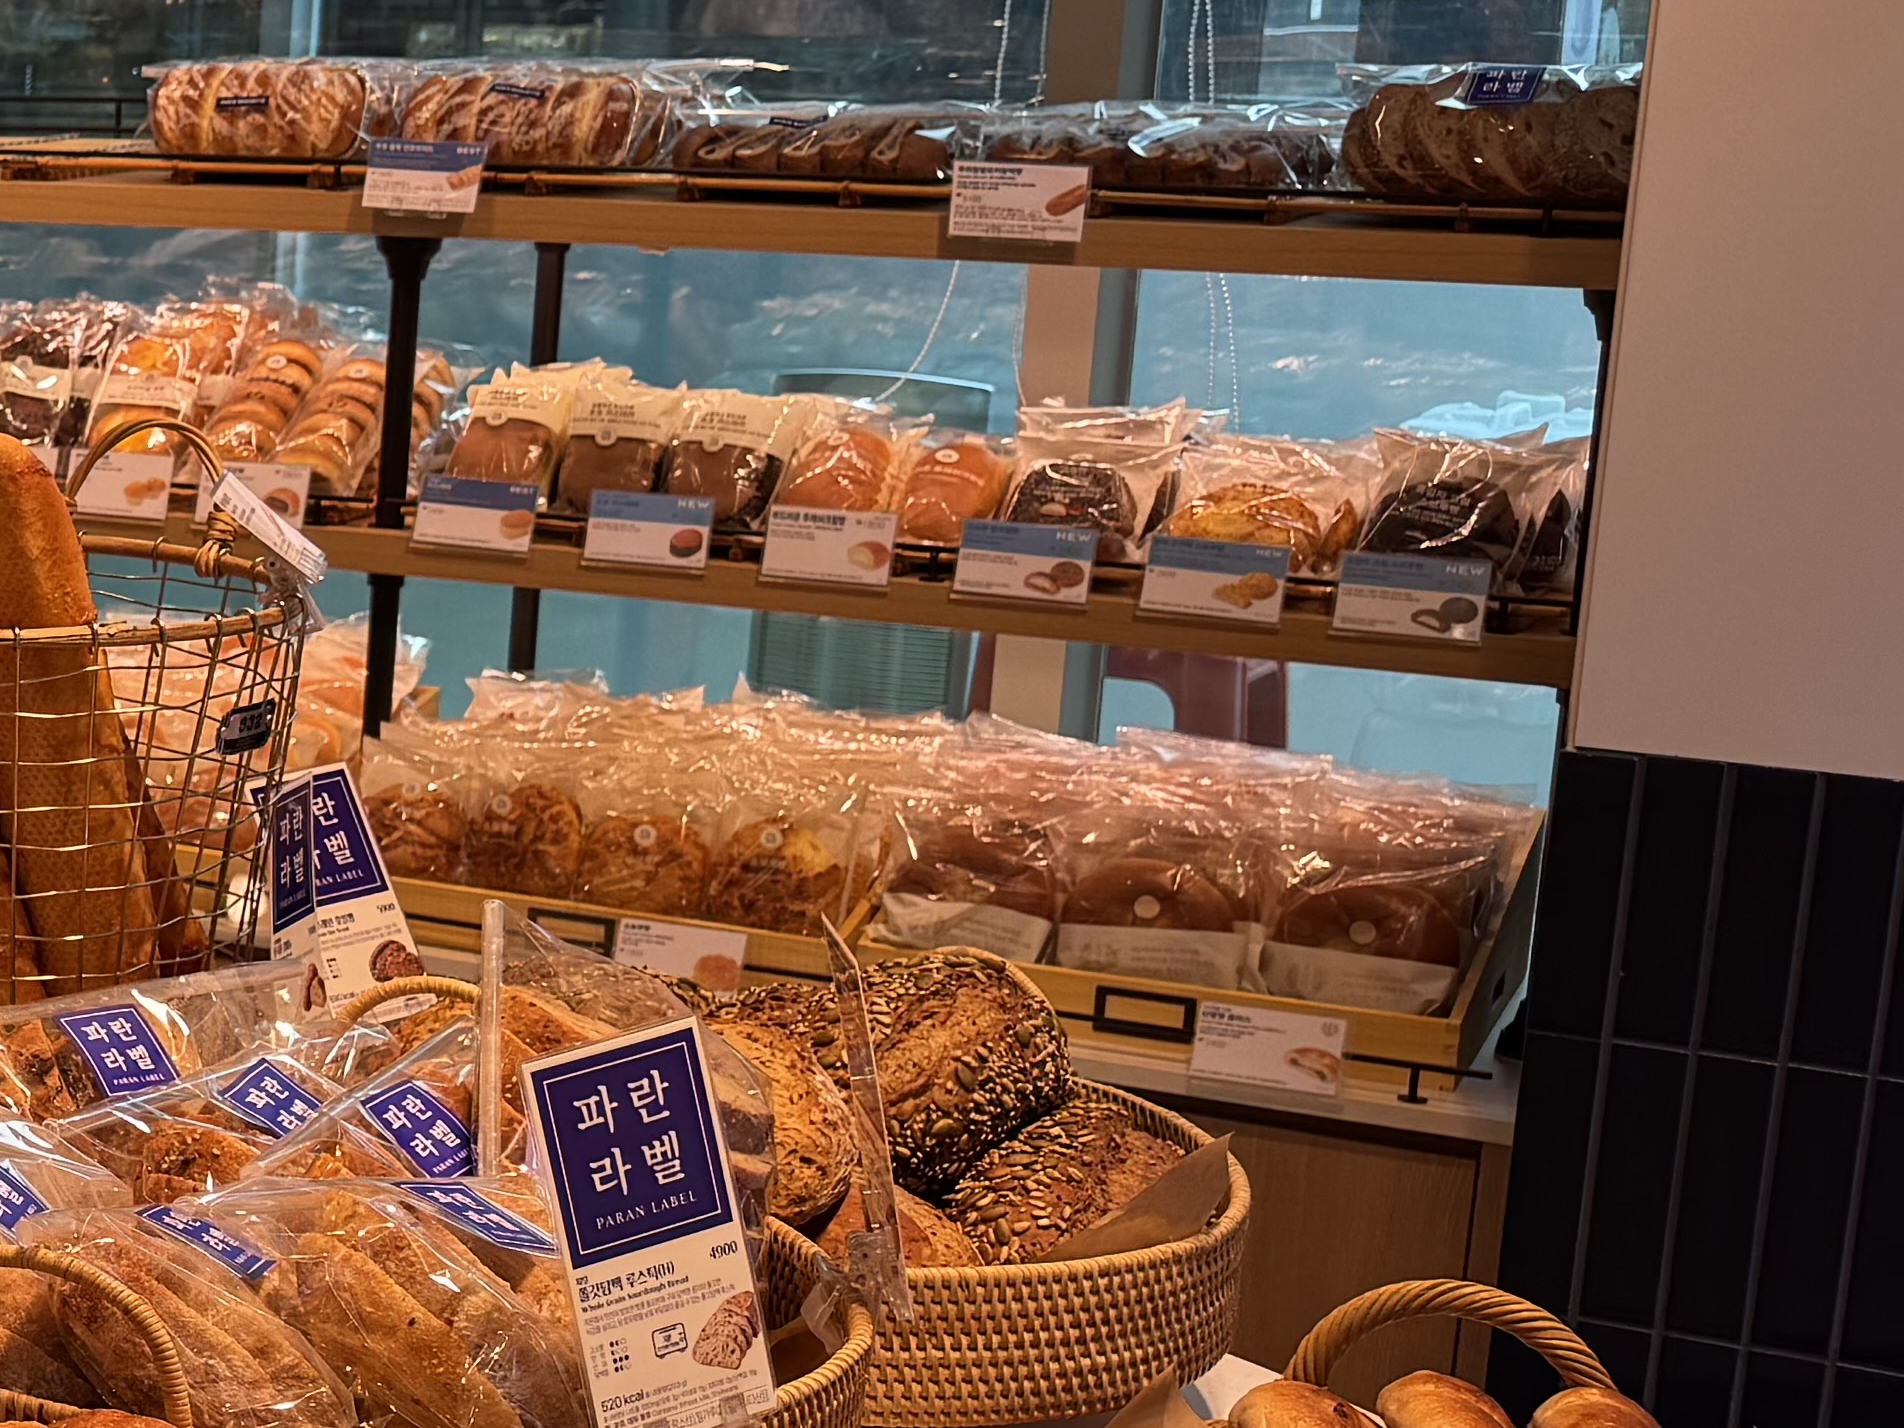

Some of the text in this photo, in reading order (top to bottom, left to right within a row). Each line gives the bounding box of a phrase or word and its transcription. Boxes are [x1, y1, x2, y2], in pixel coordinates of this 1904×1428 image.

[313, 791, 340, 827] 란
[81, 1017, 138, 1043] 파란
[100, 1044, 156, 1072] 라벨
[382, 1094, 432, 1130] 파란
[572, 1069, 671, 1134] 파란
[409, 1119, 462, 1158] 라벨
[588, 1130, 686, 1196] 라벨
[595, 1189, 698, 1231] PARAN LABEL
[709, 1240, 739, 1260] 4900
[623, 1389, 645, 1406] kcal
